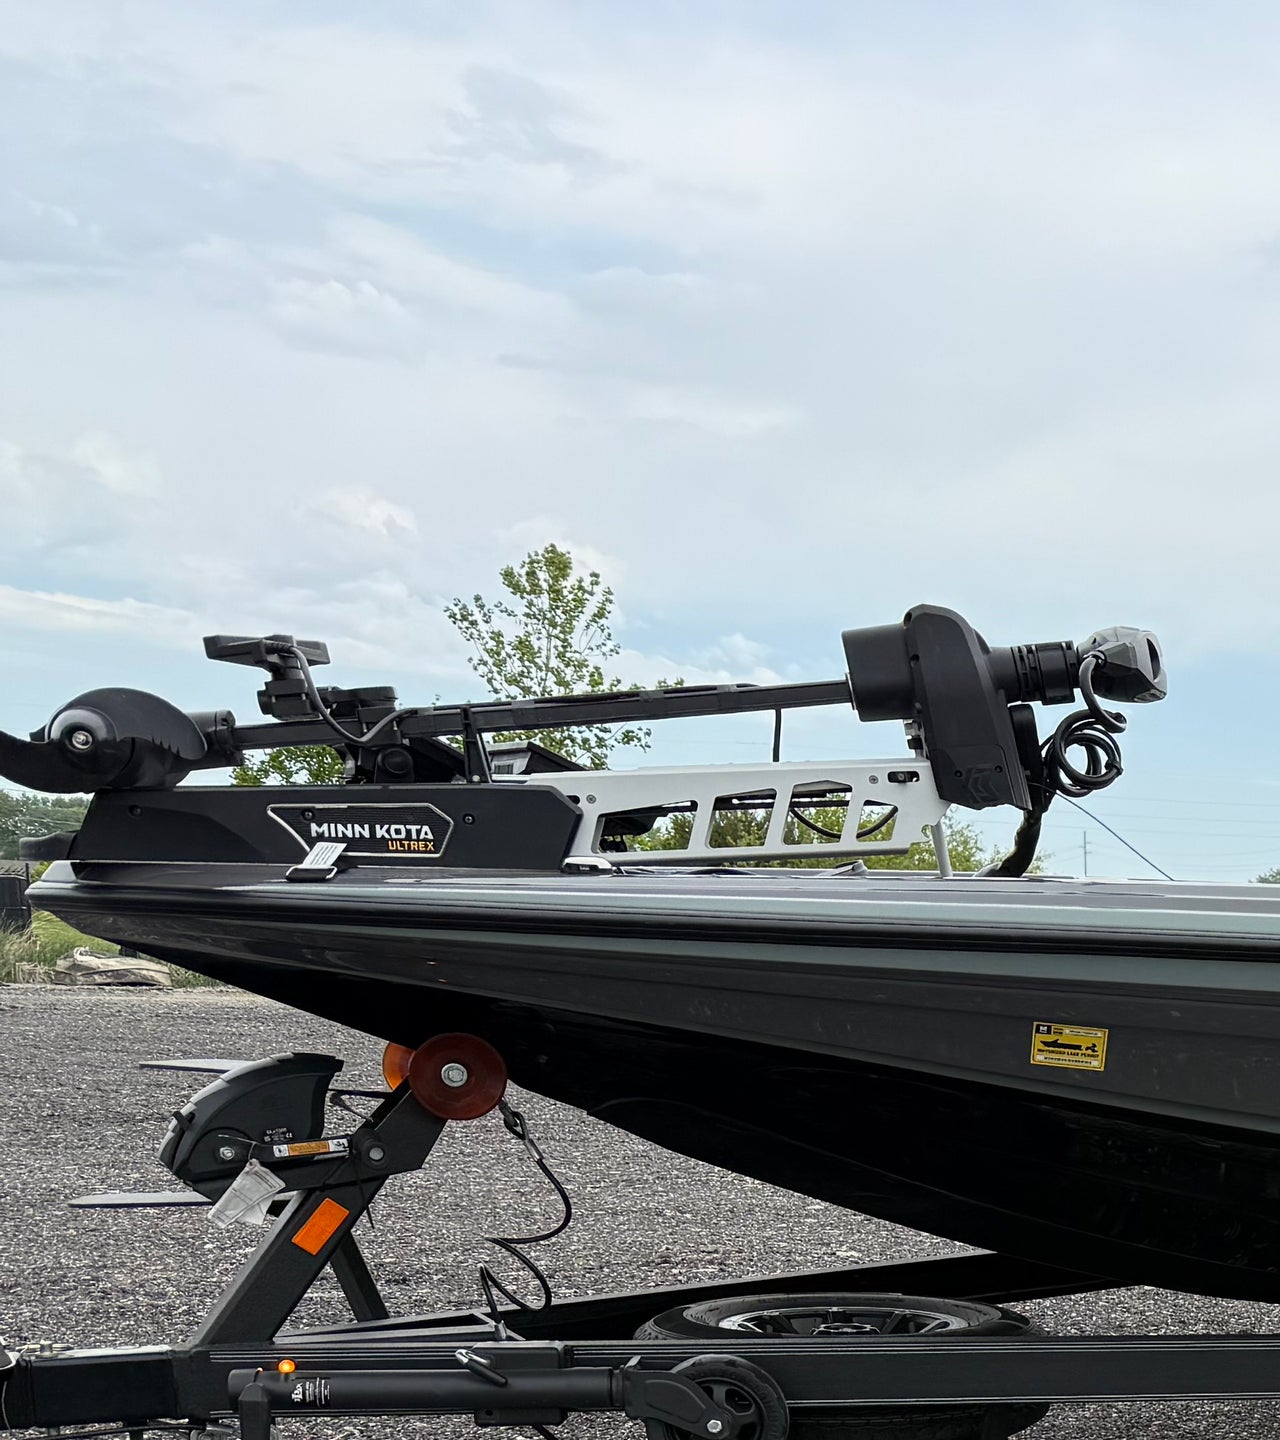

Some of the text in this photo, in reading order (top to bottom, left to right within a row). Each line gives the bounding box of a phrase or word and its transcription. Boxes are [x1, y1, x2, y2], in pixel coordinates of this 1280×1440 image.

[310, 822, 434, 840] MINN KOTA
[388, 840, 435, 851] ULTREX
